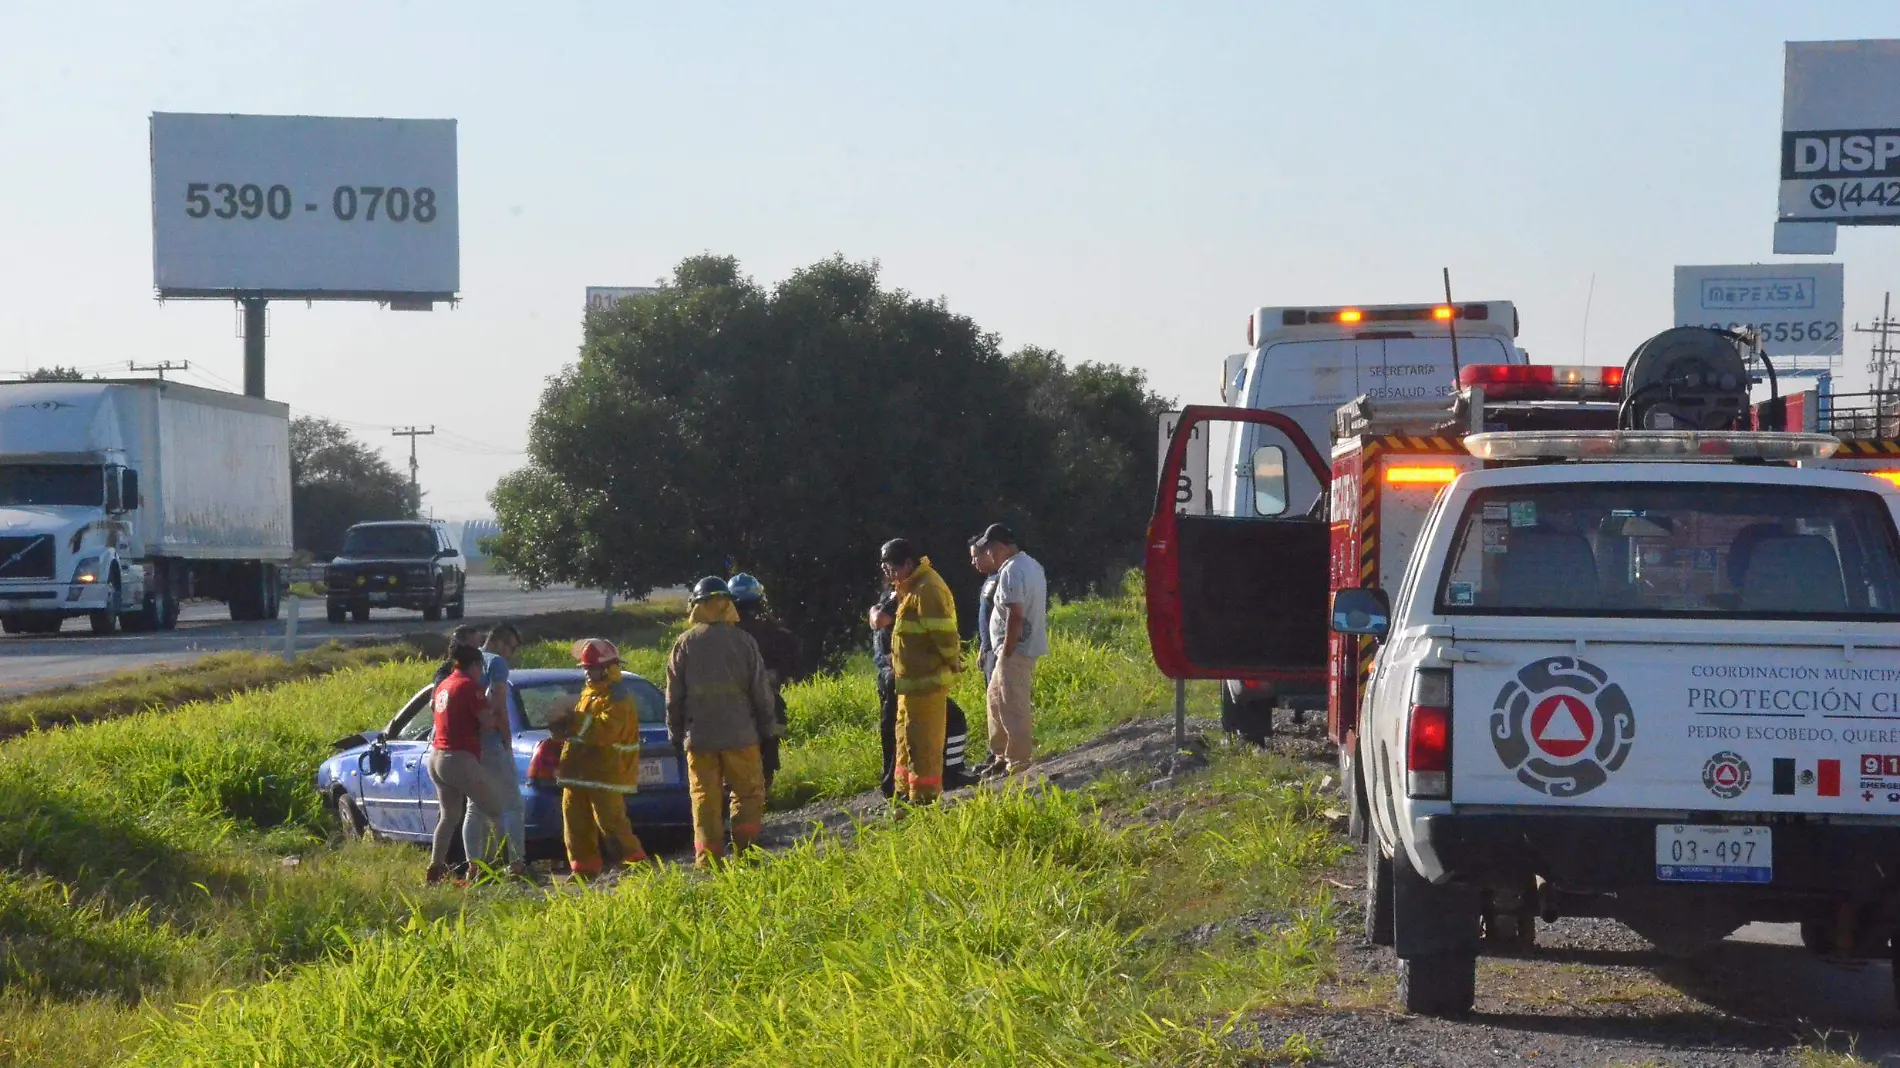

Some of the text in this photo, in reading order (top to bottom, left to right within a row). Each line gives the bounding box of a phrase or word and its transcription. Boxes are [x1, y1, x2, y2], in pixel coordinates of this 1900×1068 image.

[1795, 135, 1900, 172] DISP
[186, 183, 437, 222] 5390 - 0708
[1839, 182, 1900, 212] (442
[1370, 364, 1435, 377] SECRETARÍA
[1370, 388, 1385, 399] DE
[1388, 386, 1425, 398] SALUD
[1691, 665, 1820, 680] COORDINACIÓN
[1687, 686, 1862, 712] PROTECCIÓN
[1688, 725, 1900, 744] PEDRO ESCOBEDO, QUERÉ
[1672, 840, 1756, 863] 03-497
